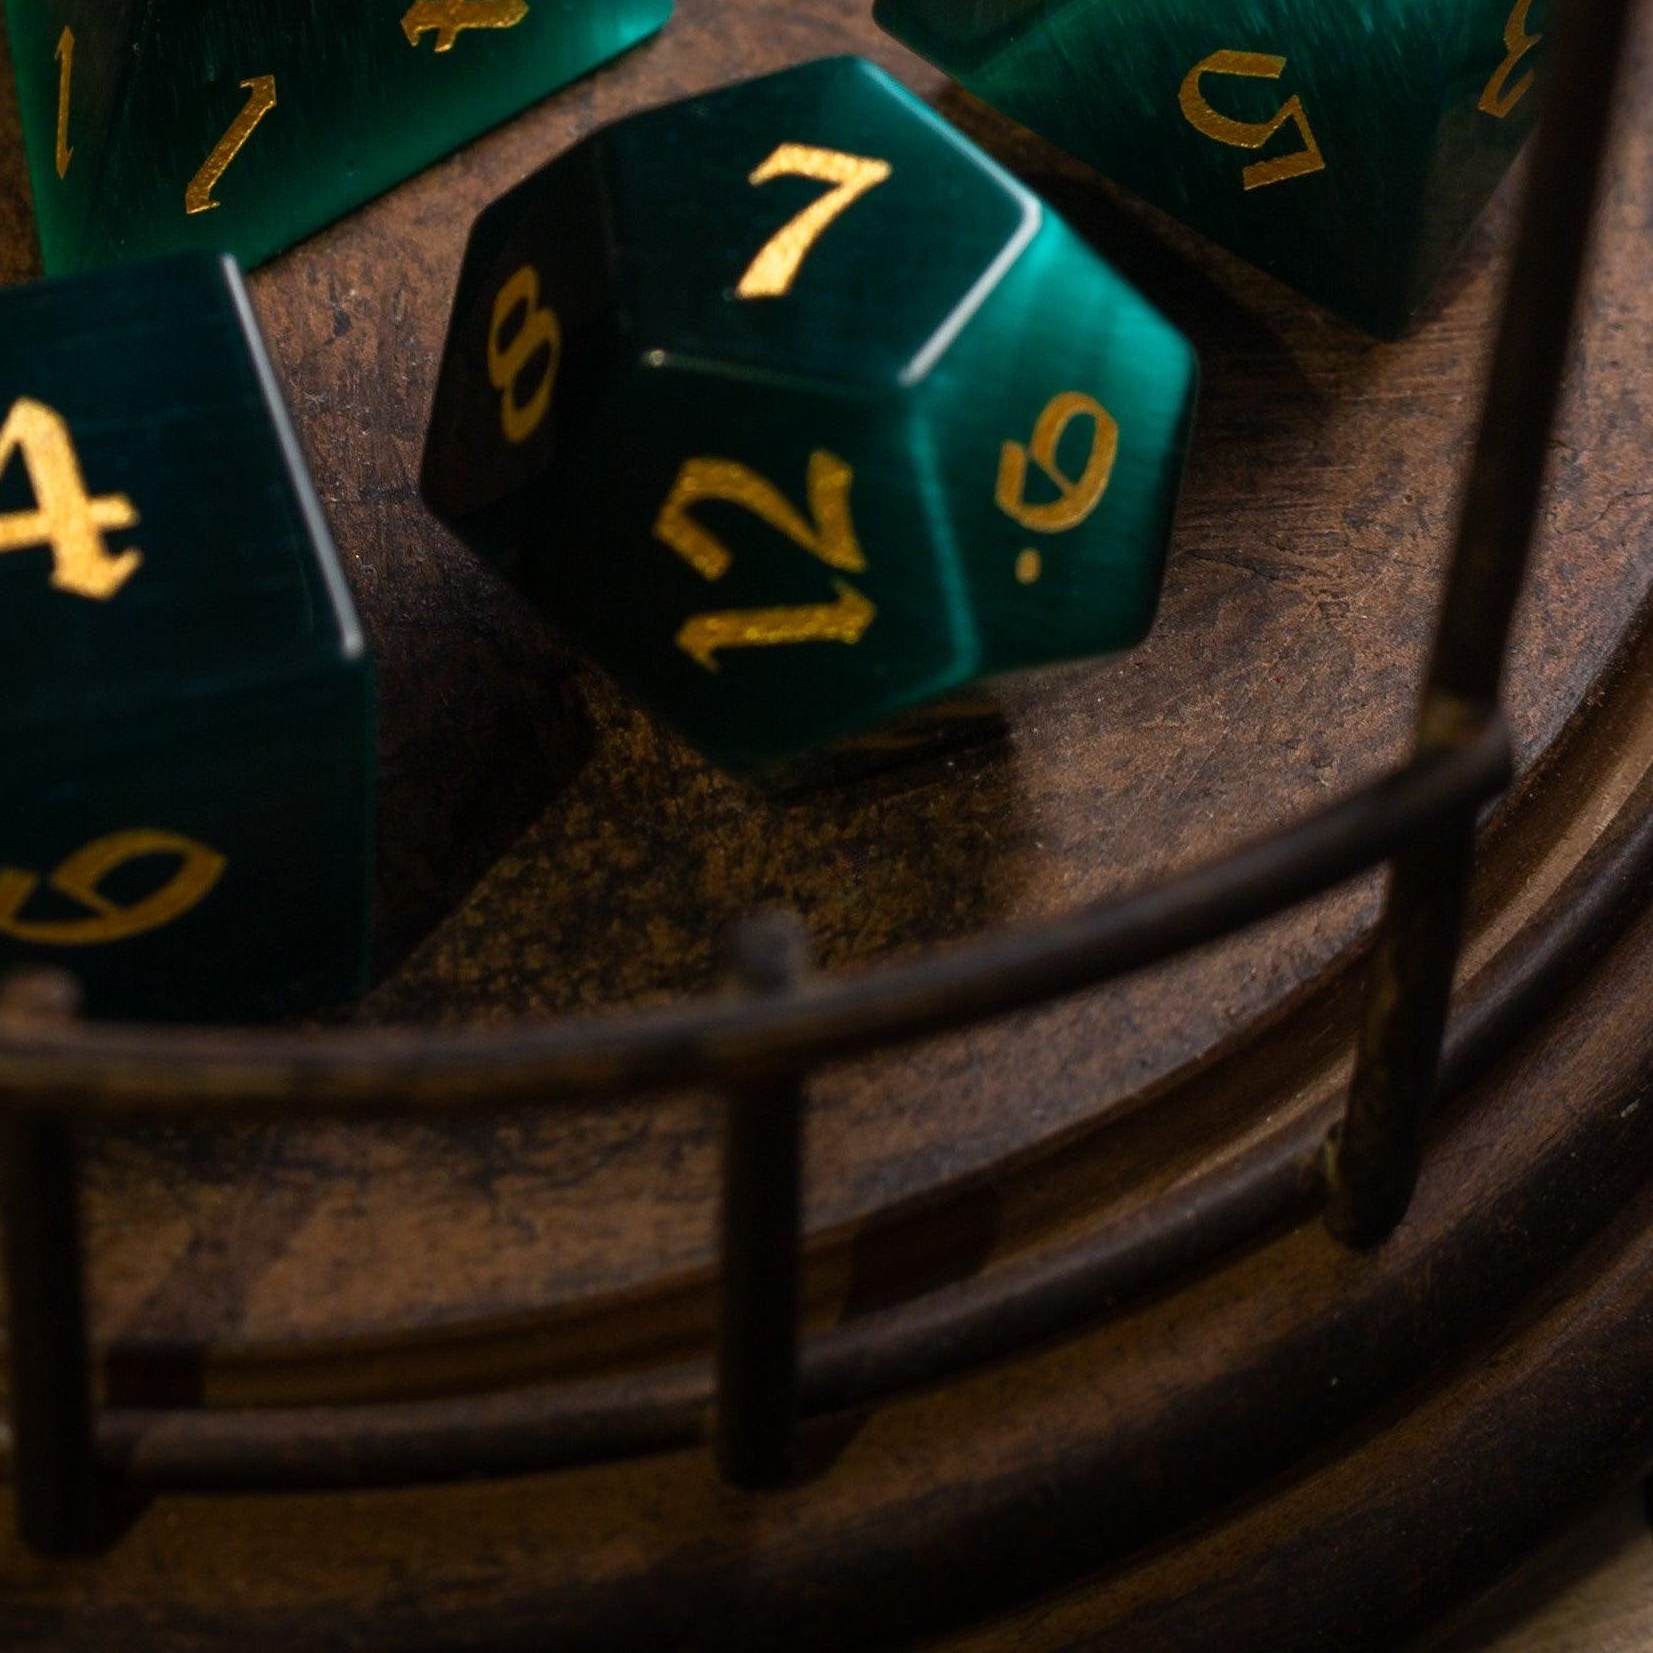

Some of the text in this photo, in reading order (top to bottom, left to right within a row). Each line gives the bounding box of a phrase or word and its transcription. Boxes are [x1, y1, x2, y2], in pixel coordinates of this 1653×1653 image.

[56, 27, 75, 176] 1
[185, 76, 277, 214] 1
[1180, 50, 1324, 189] 5
[737, 143, 889, 299] 7
[487, 265, 561, 442] 8
[654, 450, 876, 672] 12
